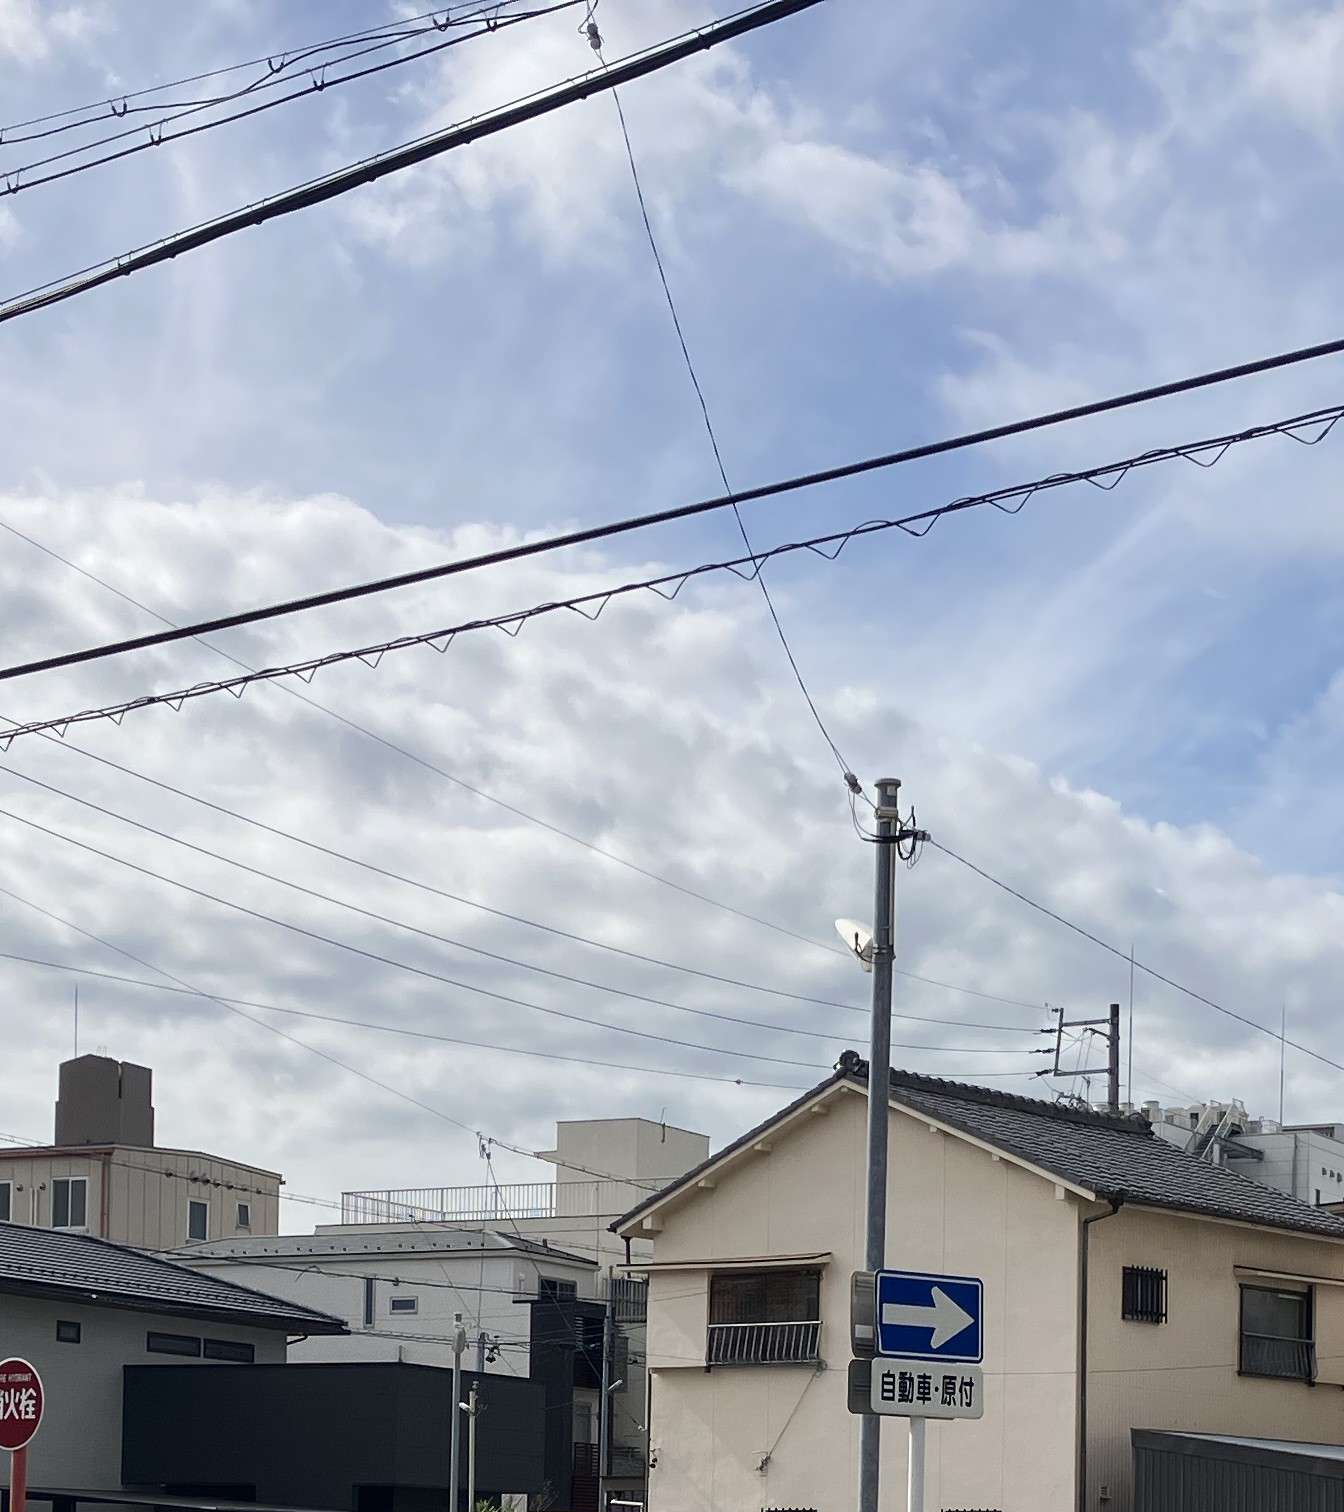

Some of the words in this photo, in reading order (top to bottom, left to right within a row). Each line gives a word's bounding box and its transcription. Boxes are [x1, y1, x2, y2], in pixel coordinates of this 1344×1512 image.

[881, 1370, 974, 1408] 自動車・原付
